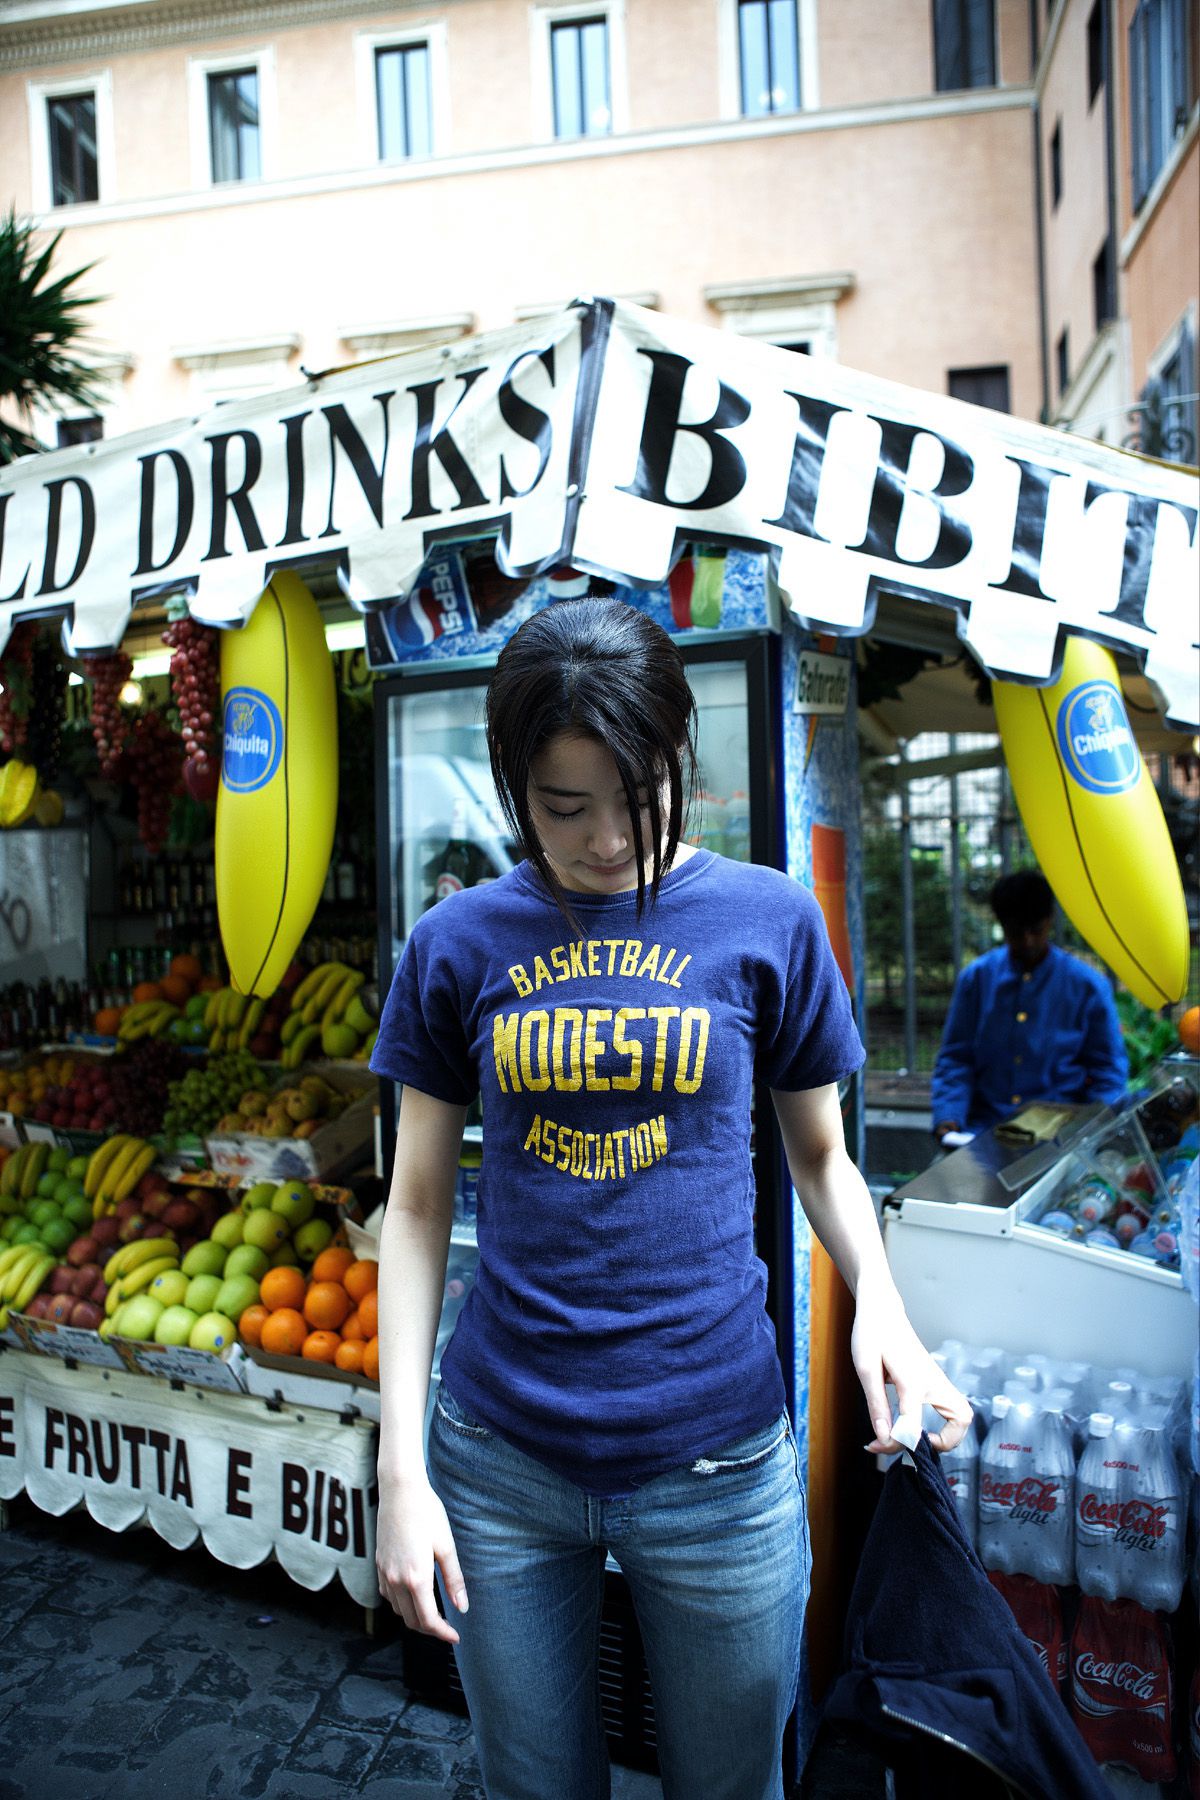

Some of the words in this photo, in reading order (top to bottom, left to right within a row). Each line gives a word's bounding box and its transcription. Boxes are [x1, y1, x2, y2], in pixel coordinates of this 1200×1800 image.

[131, 343, 558, 577] DRINKS
[613, 347, 1200, 648] BIBIT
[429, 561, 465, 637] PEPSI
[224, 733, 269, 758] Chiquita
[507, 939, 692, 998] BASKETBALL
[492, 1006, 711, 1094] MODESTO
[523, 1113, 668, 1180] ASSOCIATION
[44, 1406, 193, 1508] FRUTTA
[226, 1447, 253, 1519] E
[1009, 1502, 1049, 1526] light
[1112, 1526, 1157, 1552] light
